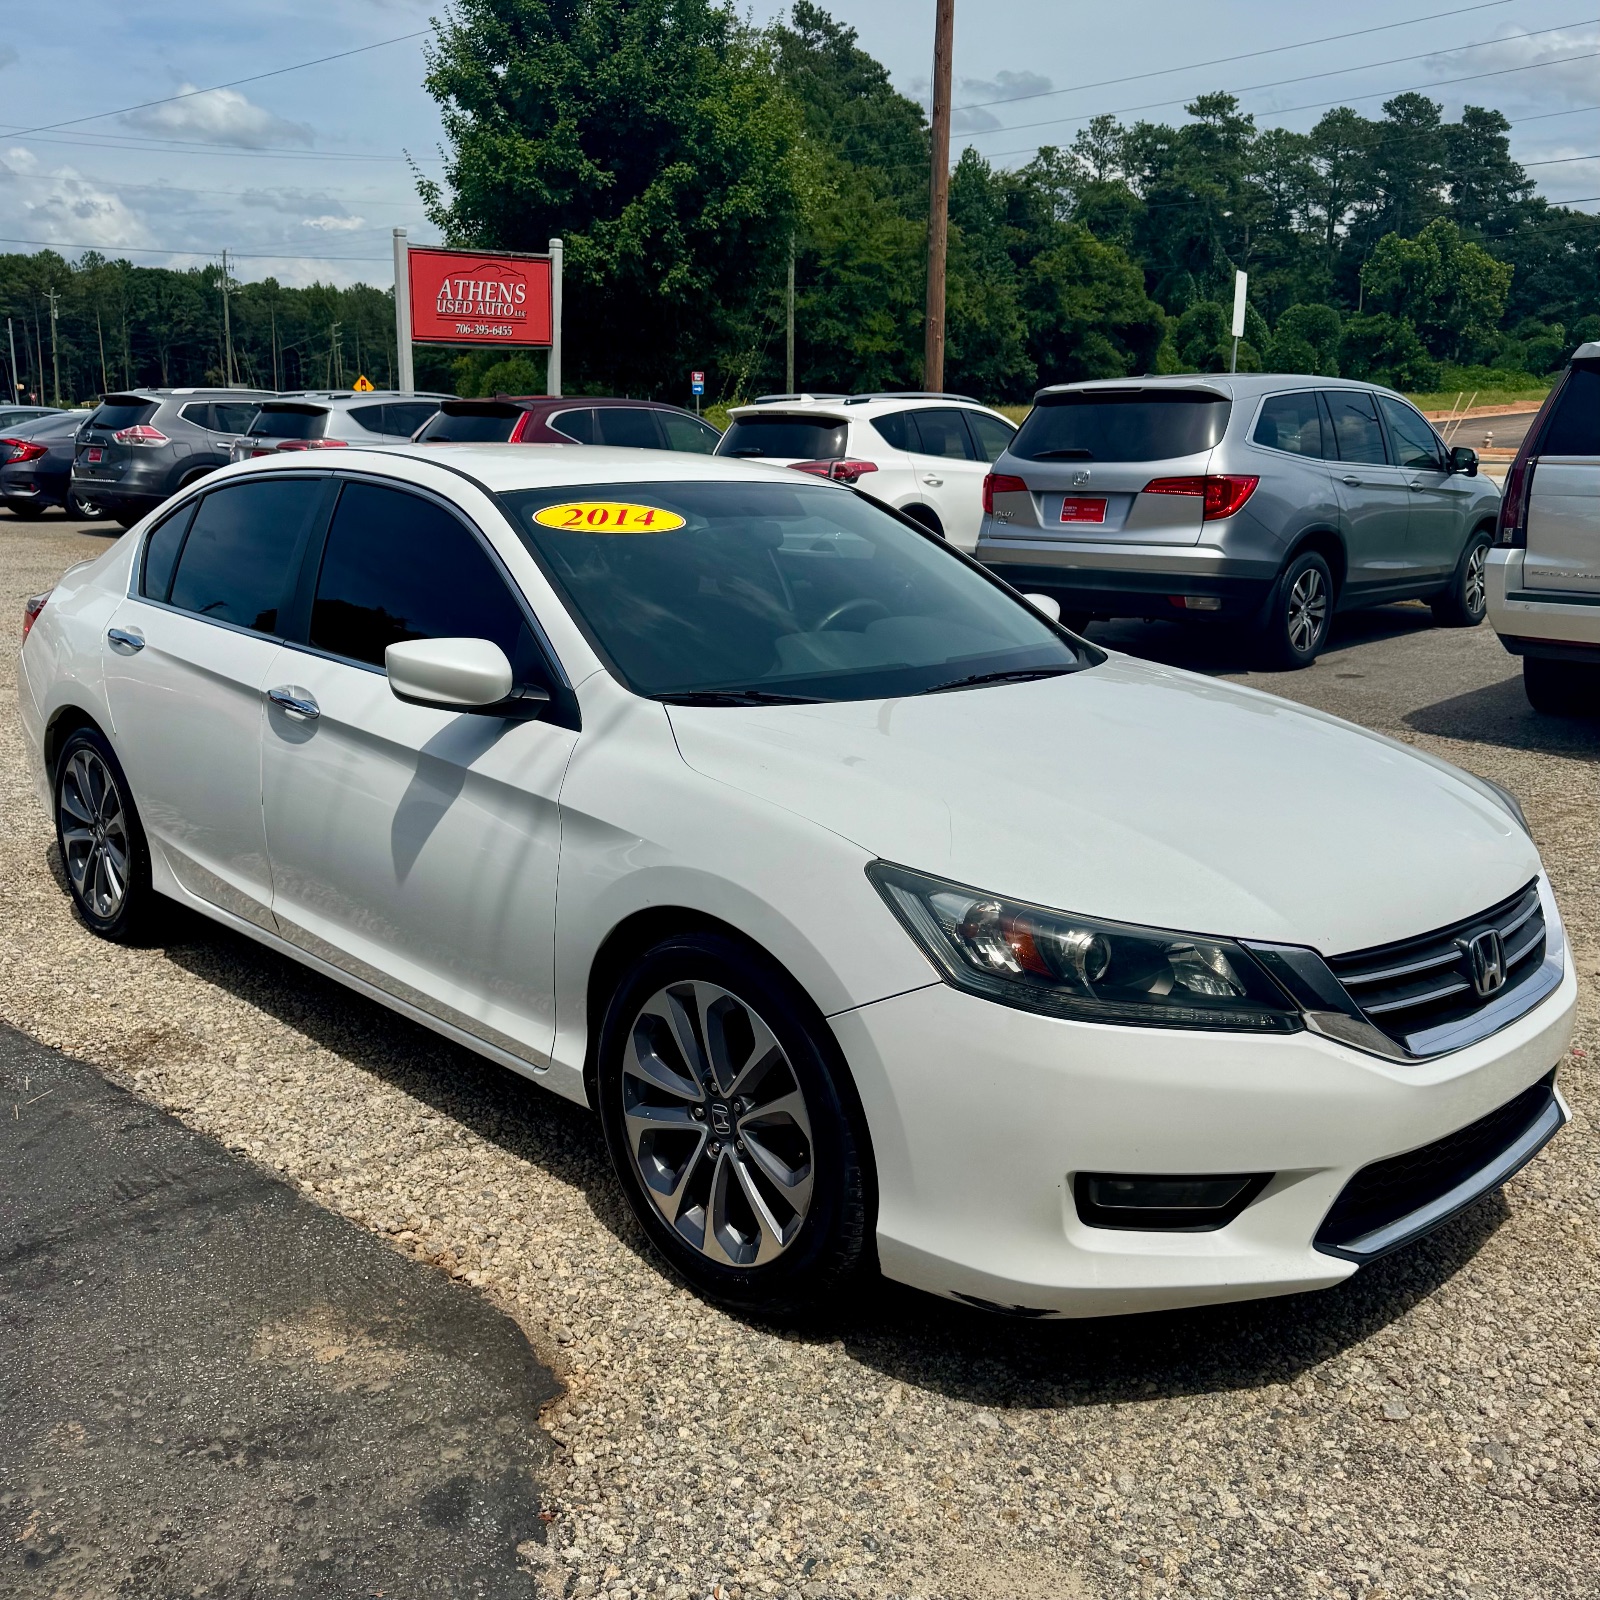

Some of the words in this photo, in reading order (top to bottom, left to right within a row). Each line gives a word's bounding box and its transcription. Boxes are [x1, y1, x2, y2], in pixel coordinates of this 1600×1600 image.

[437, 279, 526, 304] ATHENS
[436, 300, 473, 314] USED
[476, 302, 514, 316] AUTO
[455, 323, 513, 336] 706-395-6455
[561, 508, 655, 527] 2014
